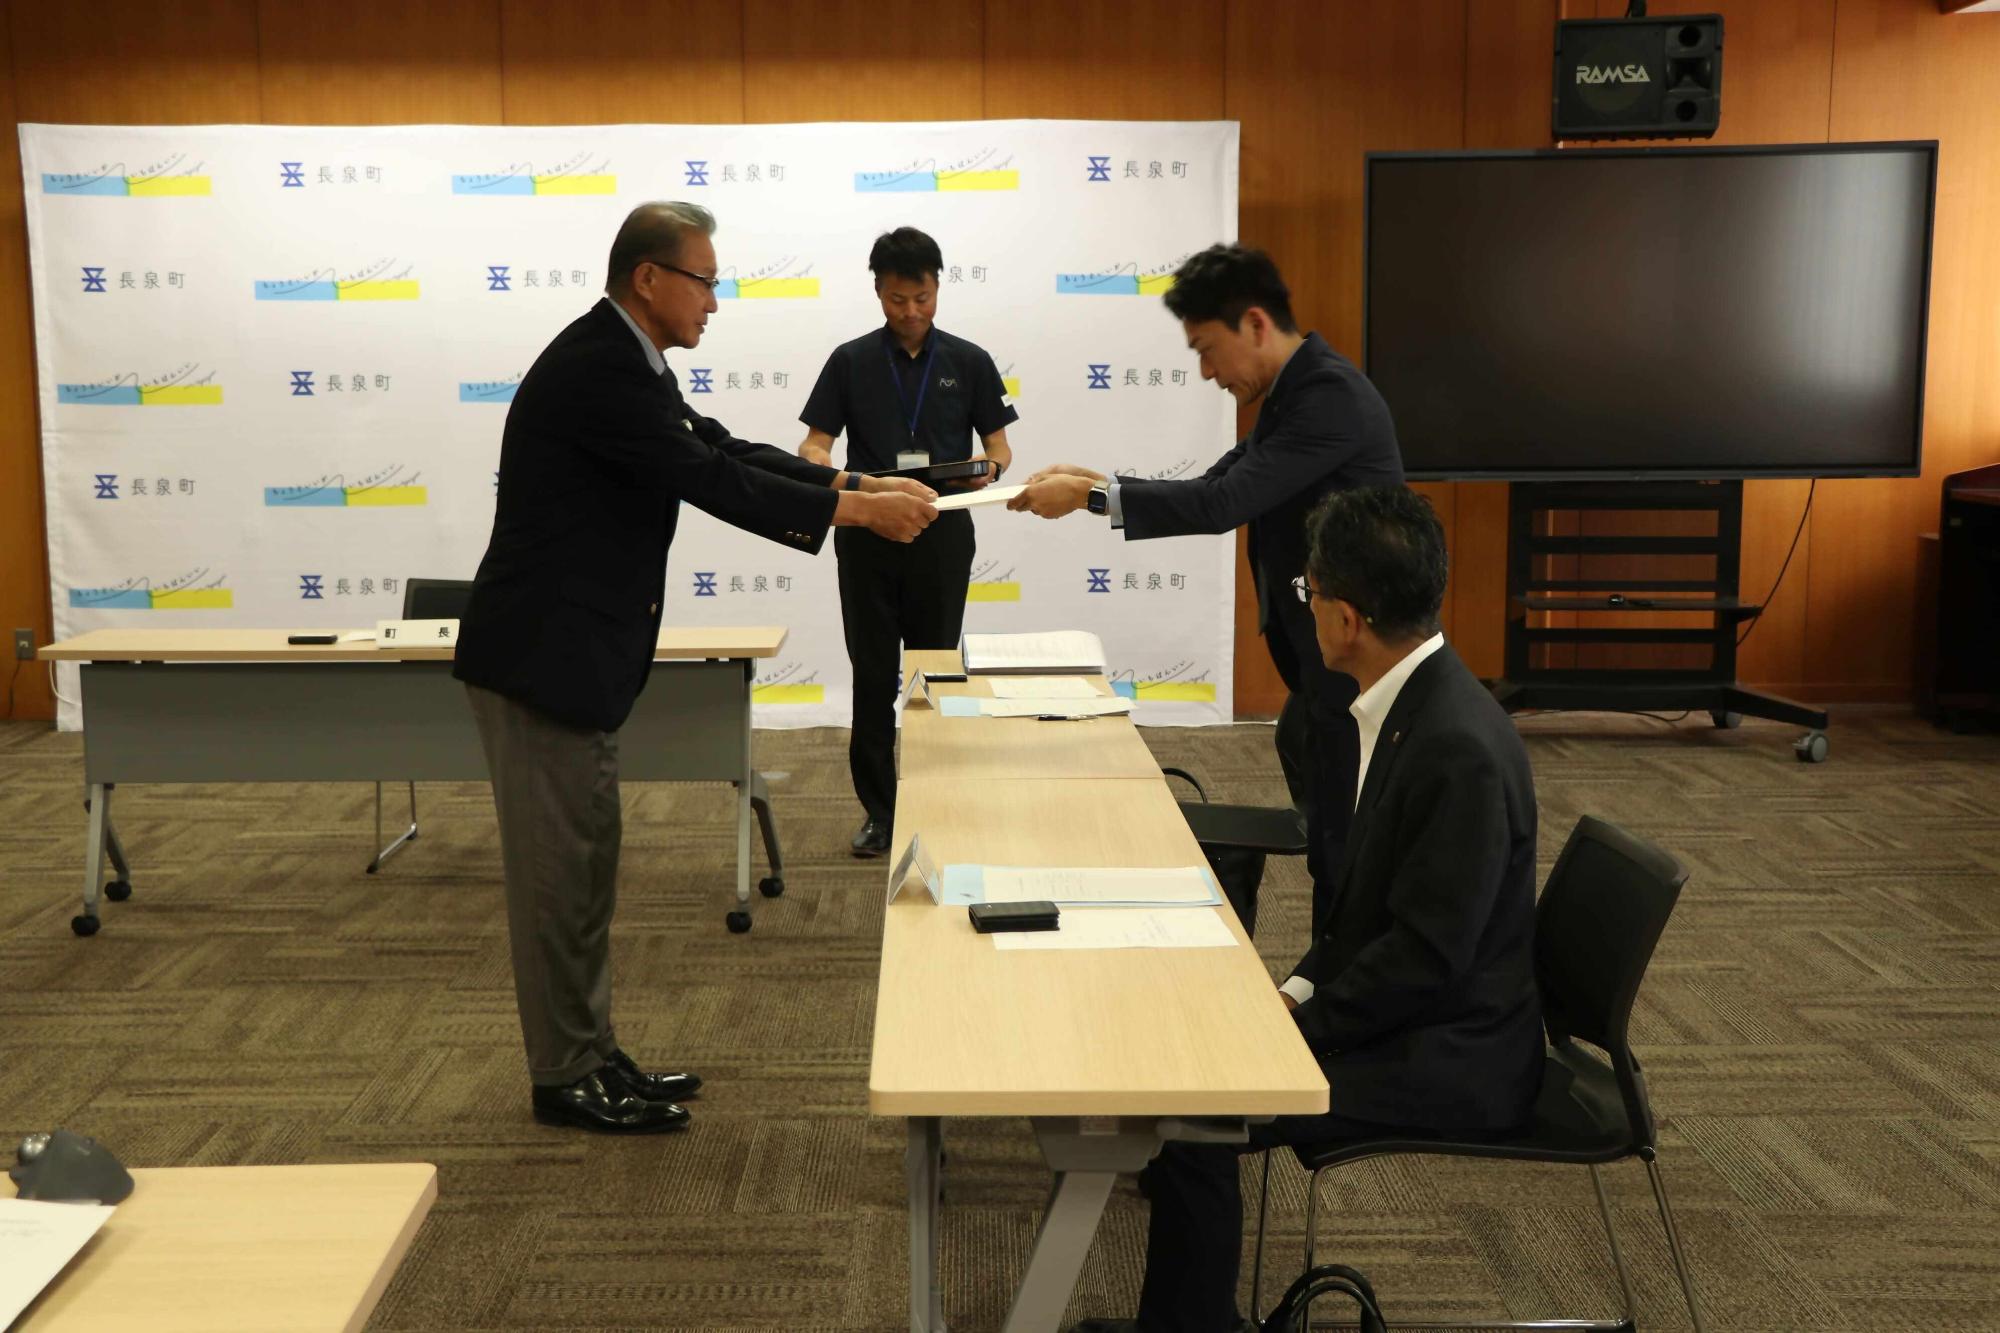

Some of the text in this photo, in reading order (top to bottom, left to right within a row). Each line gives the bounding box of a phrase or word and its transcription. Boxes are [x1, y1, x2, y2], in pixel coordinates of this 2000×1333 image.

[1576, 65, 1650, 84] RAMSA
[318, 165, 381, 184] 長泉町
[722, 163, 785, 182] 長泉町
[1123, 159, 1188, 179] 長泉町
[119, 271, 185, 290] 長泉町
[523, 269, 587, 288] 長泉町
[948, 265, 988, 284] 泉町
[326, 373, 391, 393] 長泉町
[725, 371, 789, 390] 長泉町
[1123, 367, 1189, 387] 長泉町
[130, 477, 196, 497] 長泉町
[335, 577, 399, 596] 長泉町
[728, 574, 793, 593] 長泉町
[1122, 572, 1187, 591] 長泉町
